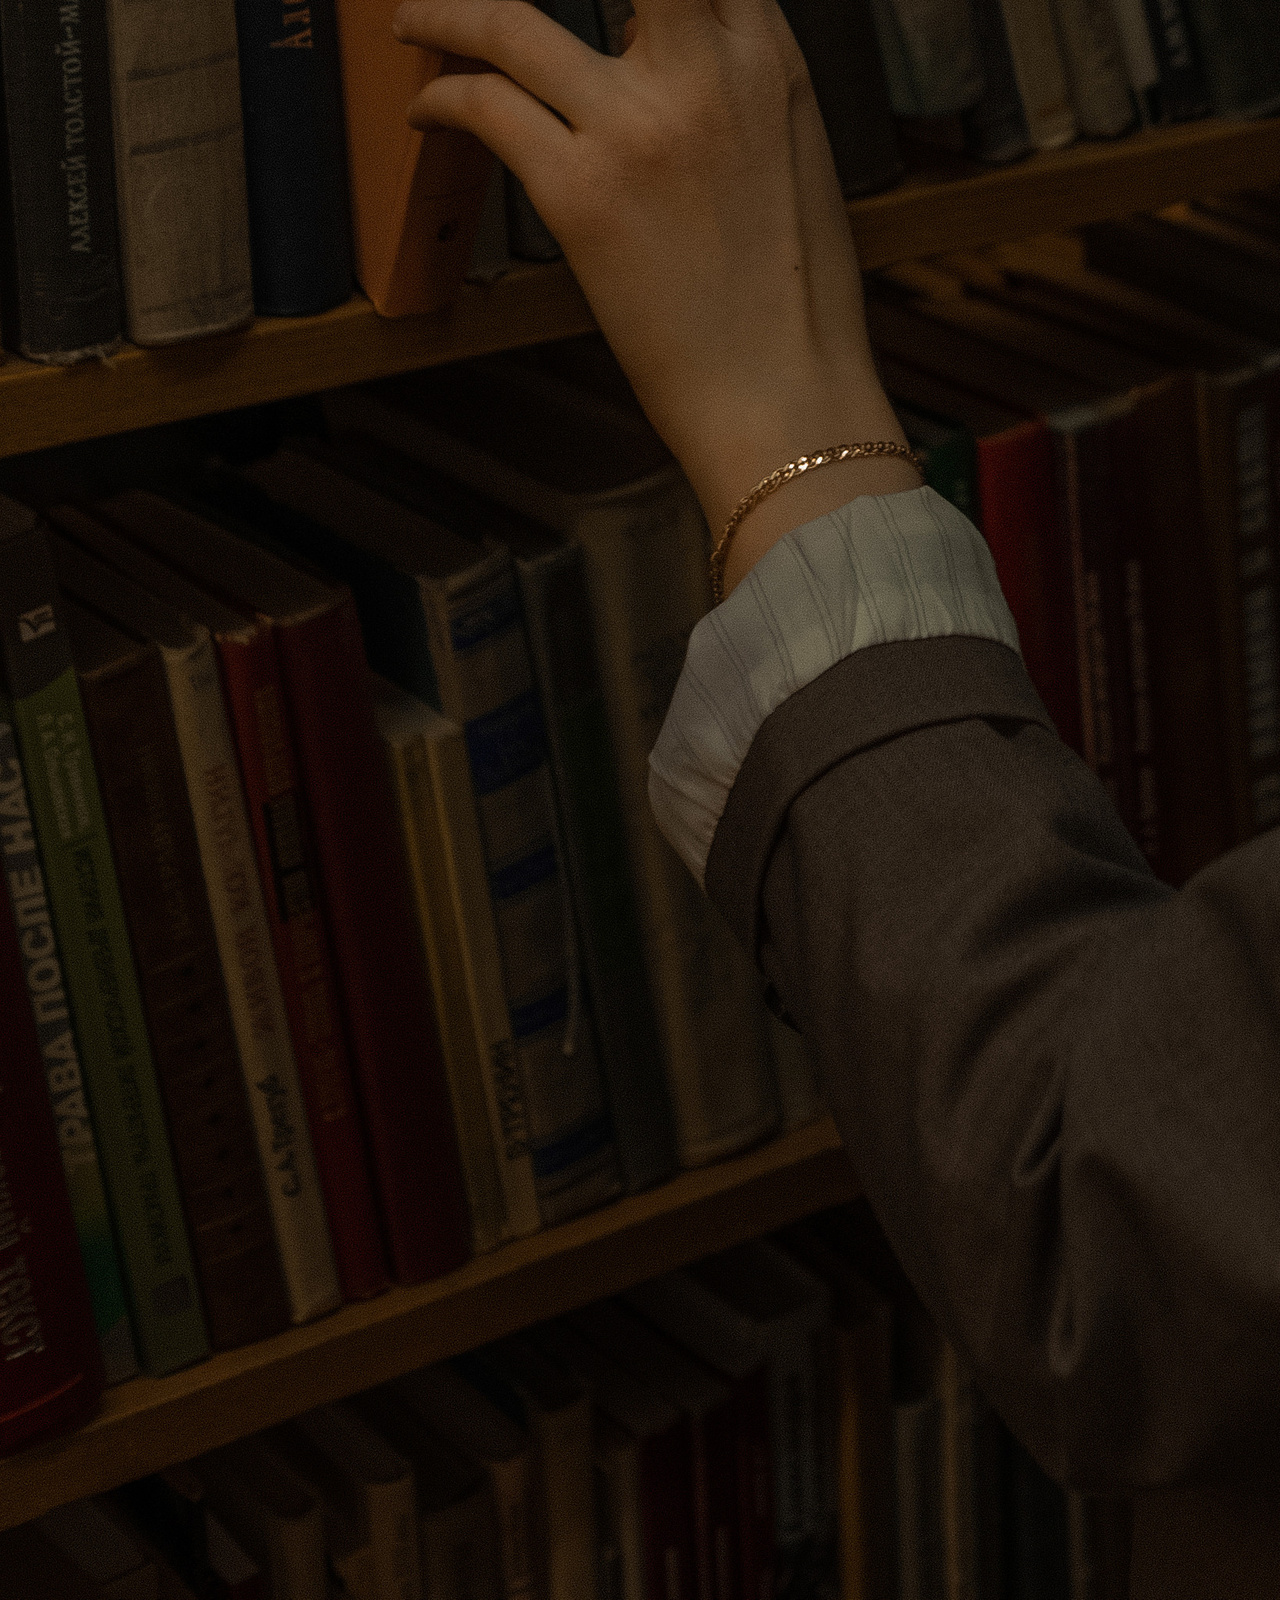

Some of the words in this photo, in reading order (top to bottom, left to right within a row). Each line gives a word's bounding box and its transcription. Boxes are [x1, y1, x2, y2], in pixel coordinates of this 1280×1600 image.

[62, 154, 92, 254] АЛЕКСЕЙ
[0, 756, 37, 856] НАС
[203, 762, 252, 911] КОЧАГИН
[9, 866, 71, 1024] ПОСЛЕ
[43, 1031, 98, 1177] ТРАВА
